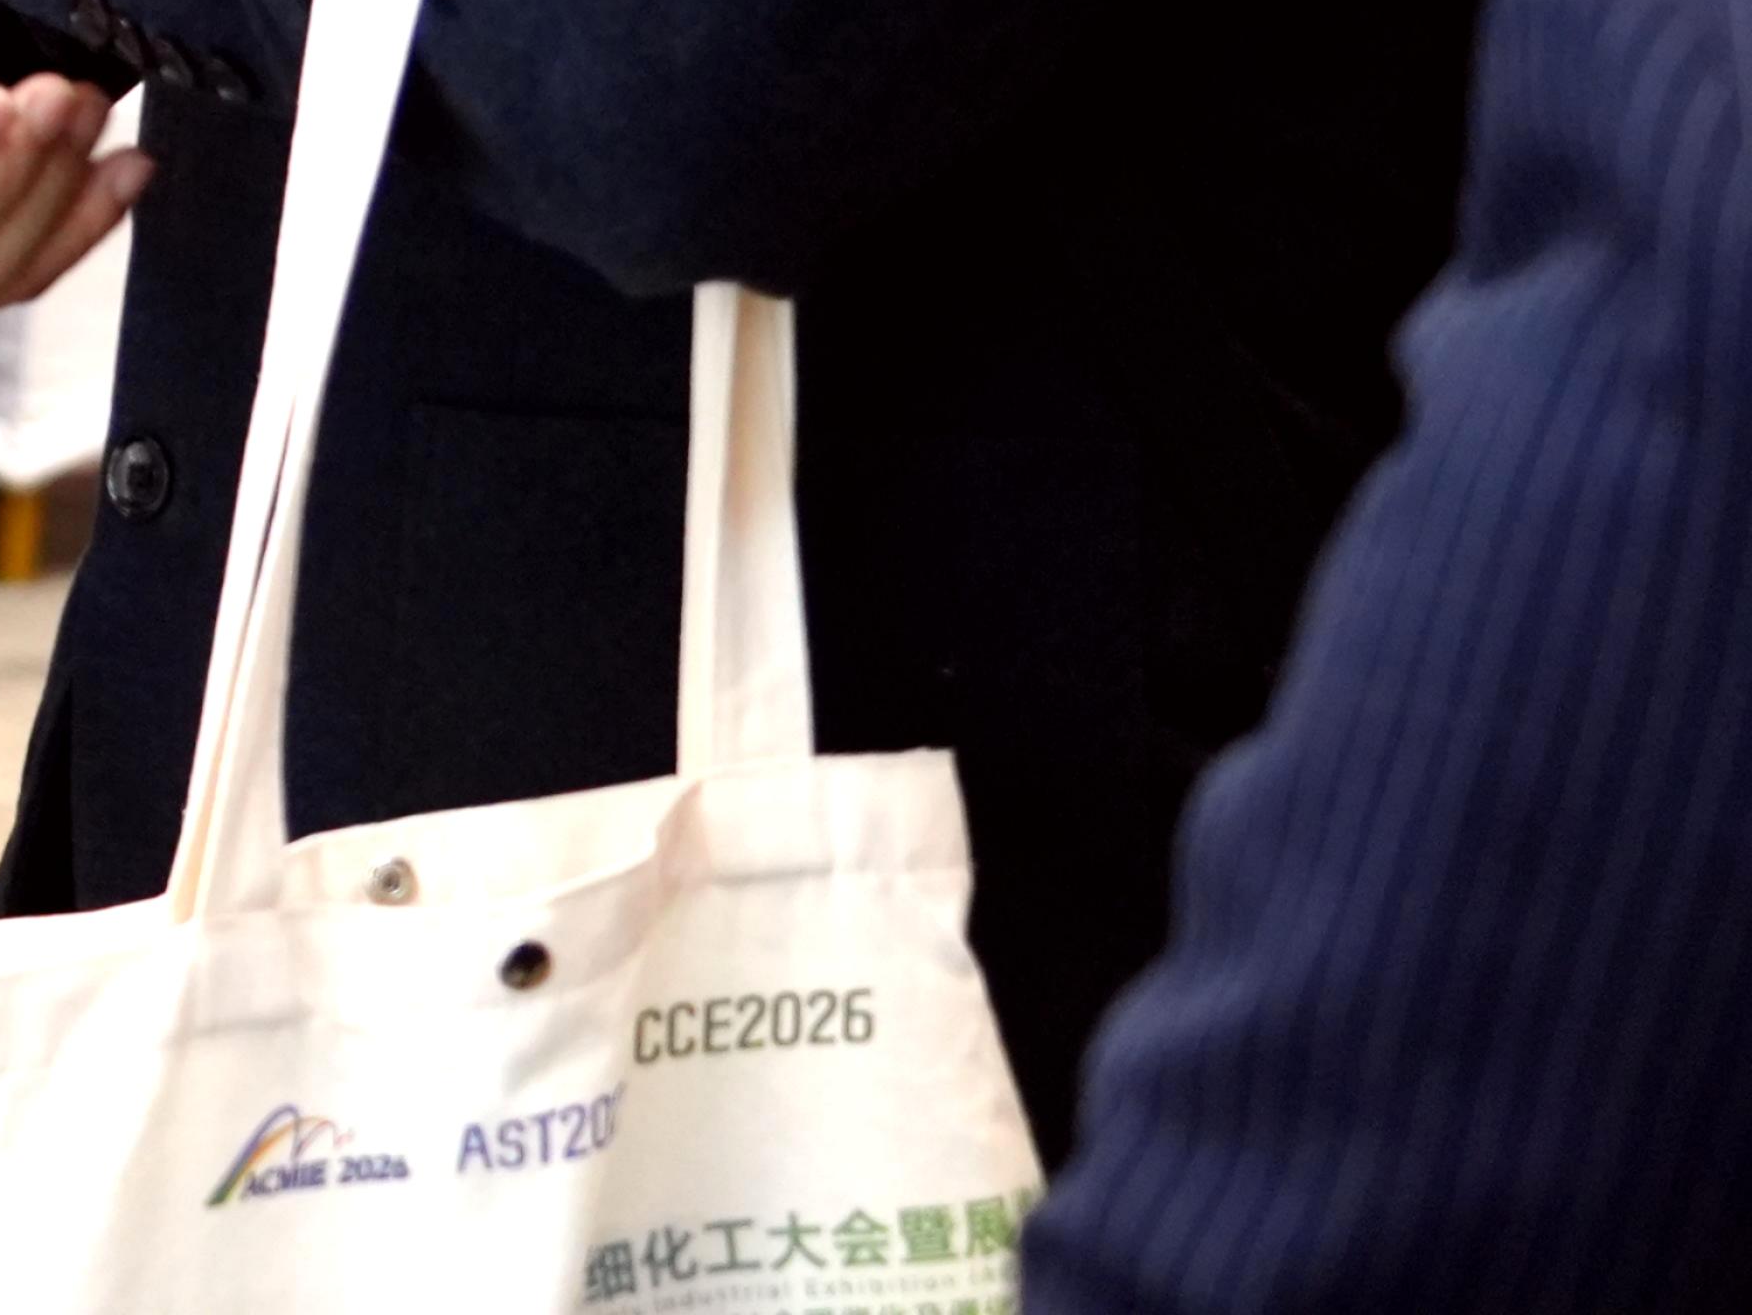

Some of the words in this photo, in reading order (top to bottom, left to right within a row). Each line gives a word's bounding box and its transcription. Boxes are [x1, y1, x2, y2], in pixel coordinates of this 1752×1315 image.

[632, 987, 875, 1065] CCE2026
[338, 1154, 411, 1183] 2026
[584, 1186, 1040, 1303] 细化工大会暨展
